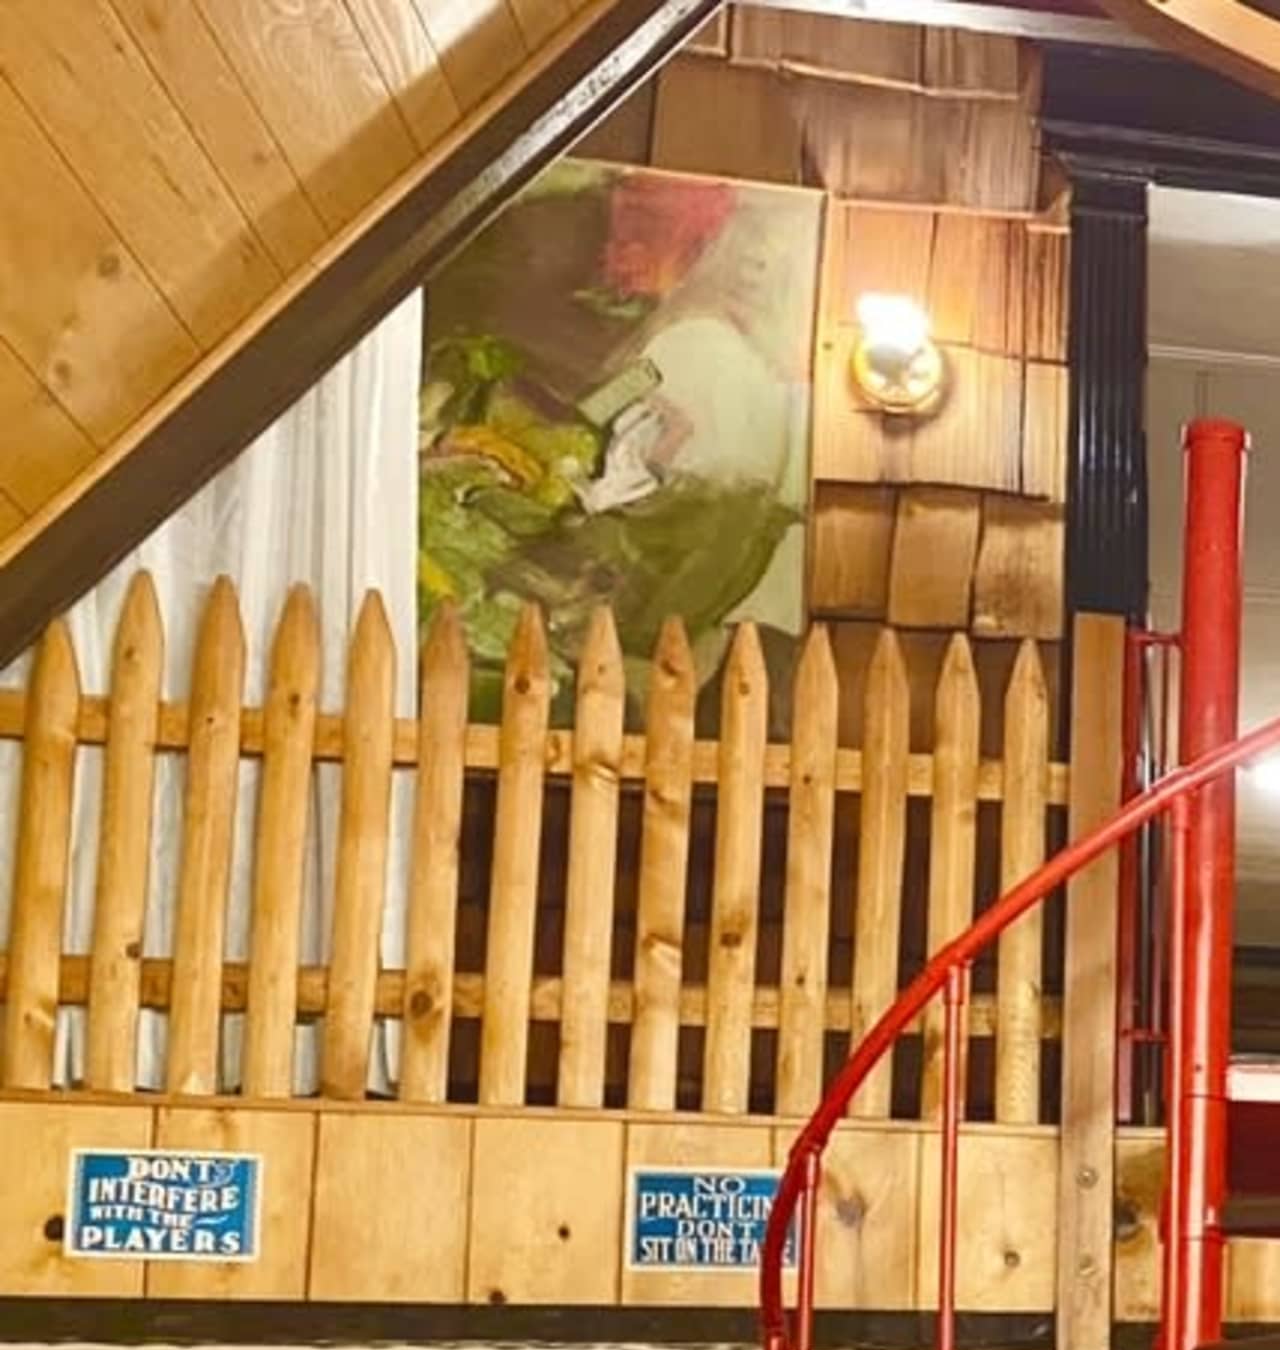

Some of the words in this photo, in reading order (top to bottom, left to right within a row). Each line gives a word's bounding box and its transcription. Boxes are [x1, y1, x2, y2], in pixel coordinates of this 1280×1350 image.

[88, 1177, 240, 1213] INTERFERE
[693, 1176, 746, 1195] NO
[90, 1204, 143, 1222] WITH
[148, 1209, 193, 1229] THE
[640, 1192, 774, 1219] PRACTICIN
[81, 1226, 241, 1254] PLAYERS
[641, 1237, 673, 1263] SIT
[675, 1237, 698, 1263] ON
[700, 1237, 736, 1263] THE
